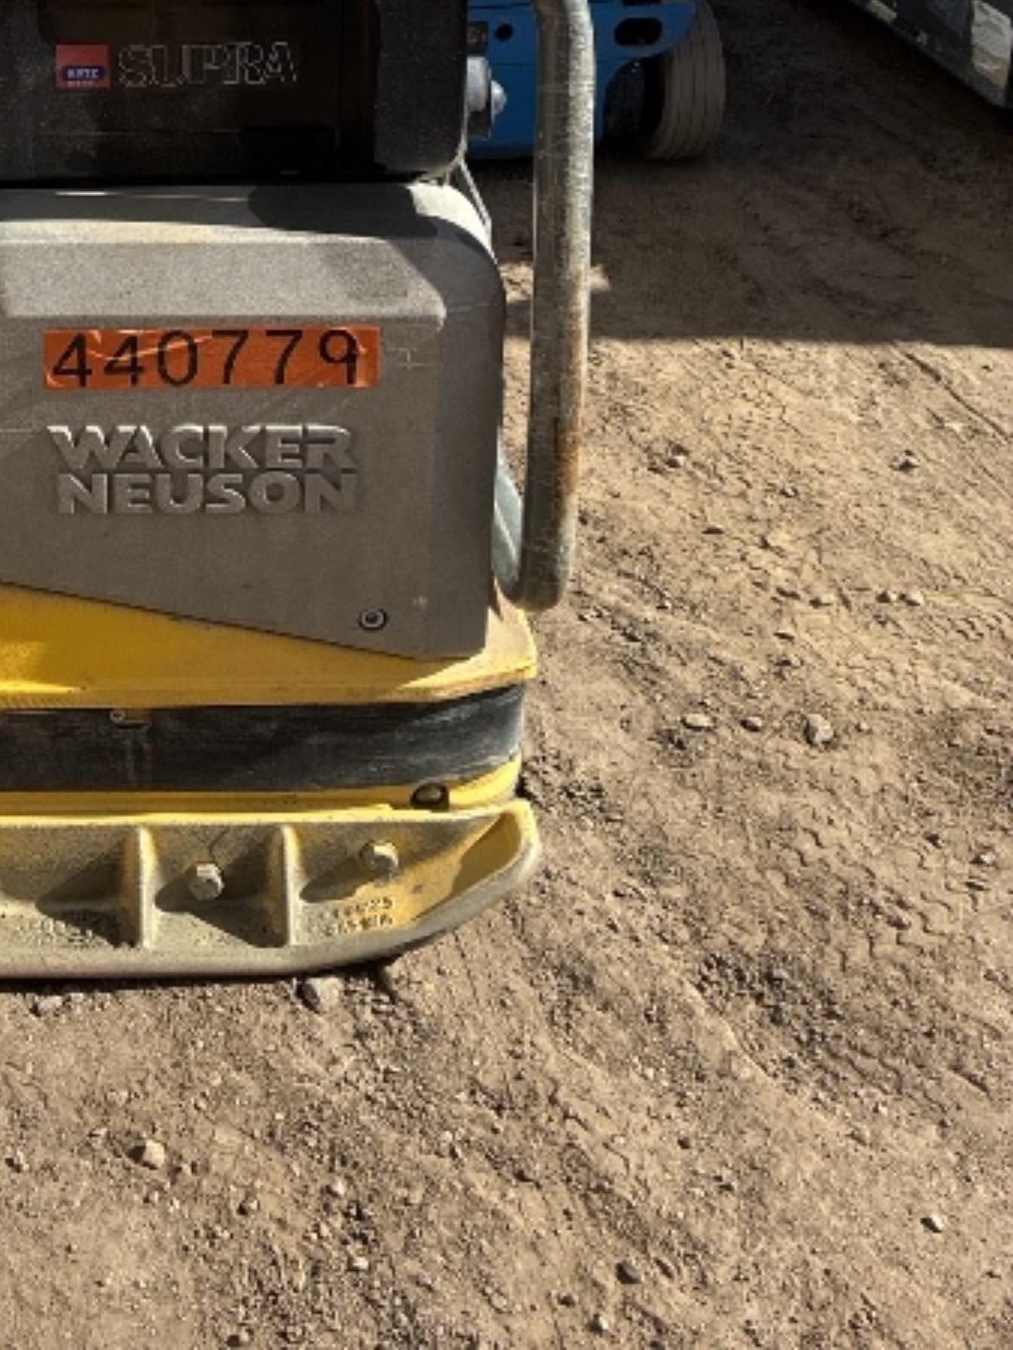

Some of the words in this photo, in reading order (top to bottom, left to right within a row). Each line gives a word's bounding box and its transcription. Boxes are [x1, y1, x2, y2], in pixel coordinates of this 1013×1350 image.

[117, 41, 298, 89] SUPRA
[52, 328, 360, 388] 440779
[46, 423, 358, 470] WACKER
[56, 471, 360, 516] NEUSON
